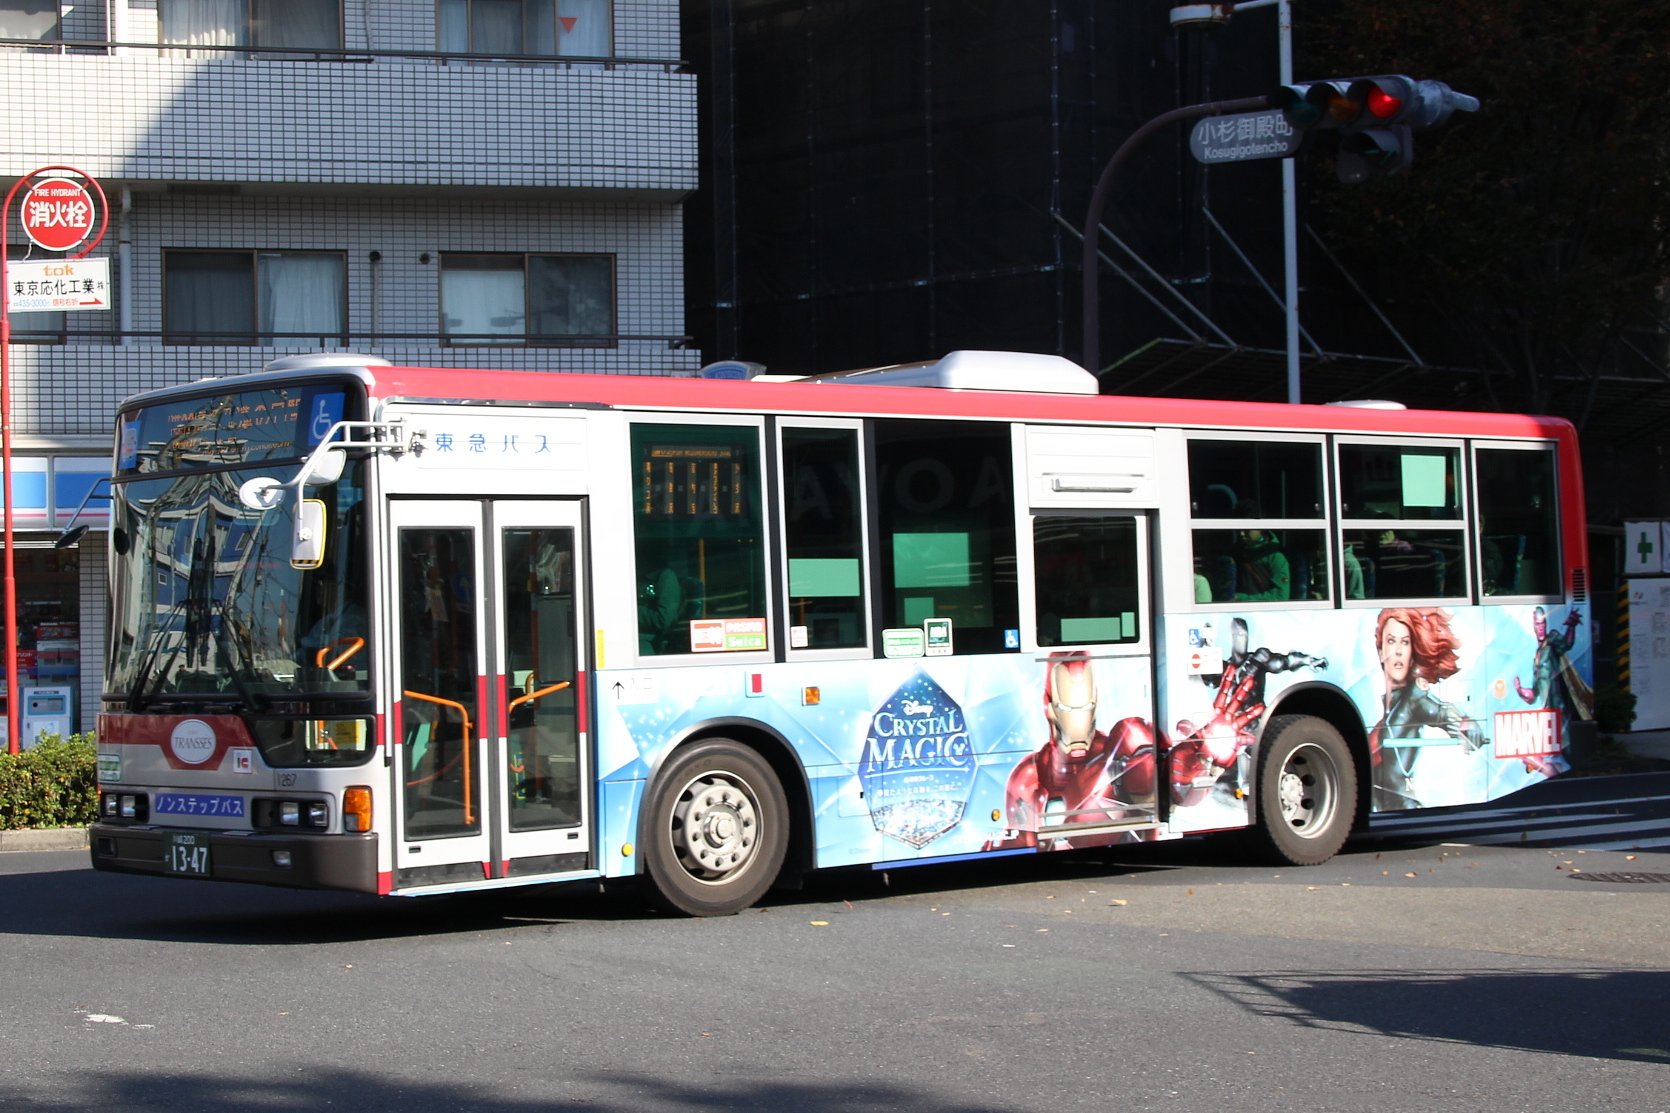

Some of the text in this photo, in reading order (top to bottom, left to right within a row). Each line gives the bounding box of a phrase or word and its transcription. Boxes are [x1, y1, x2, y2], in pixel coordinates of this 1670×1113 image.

[1197, 113, 1293, 145] 小杉御殿町
[1203, 140, 1288, 160] Kosugigotencho
[34, 188, 81, 197] FIRE HYDRANT
[29, 200, 88, 228] 消火栓
[42, 264, 75, 277] tok
[434, 432, 552, 454] 東急バス
[727, 635, 762, 647] Suica
[901, 699, 934, 718] Disney
[873, 708, 963, 737] CRYSTAL
[175, 736, 214, 750] TRANSSES
[1495, 711, 1561, 757] MARVEL
[866, 731, 969, 773] MAGIC
[277, 773, 297, 787] 1267
[156, 795, 243, 815] ノンステップバス
